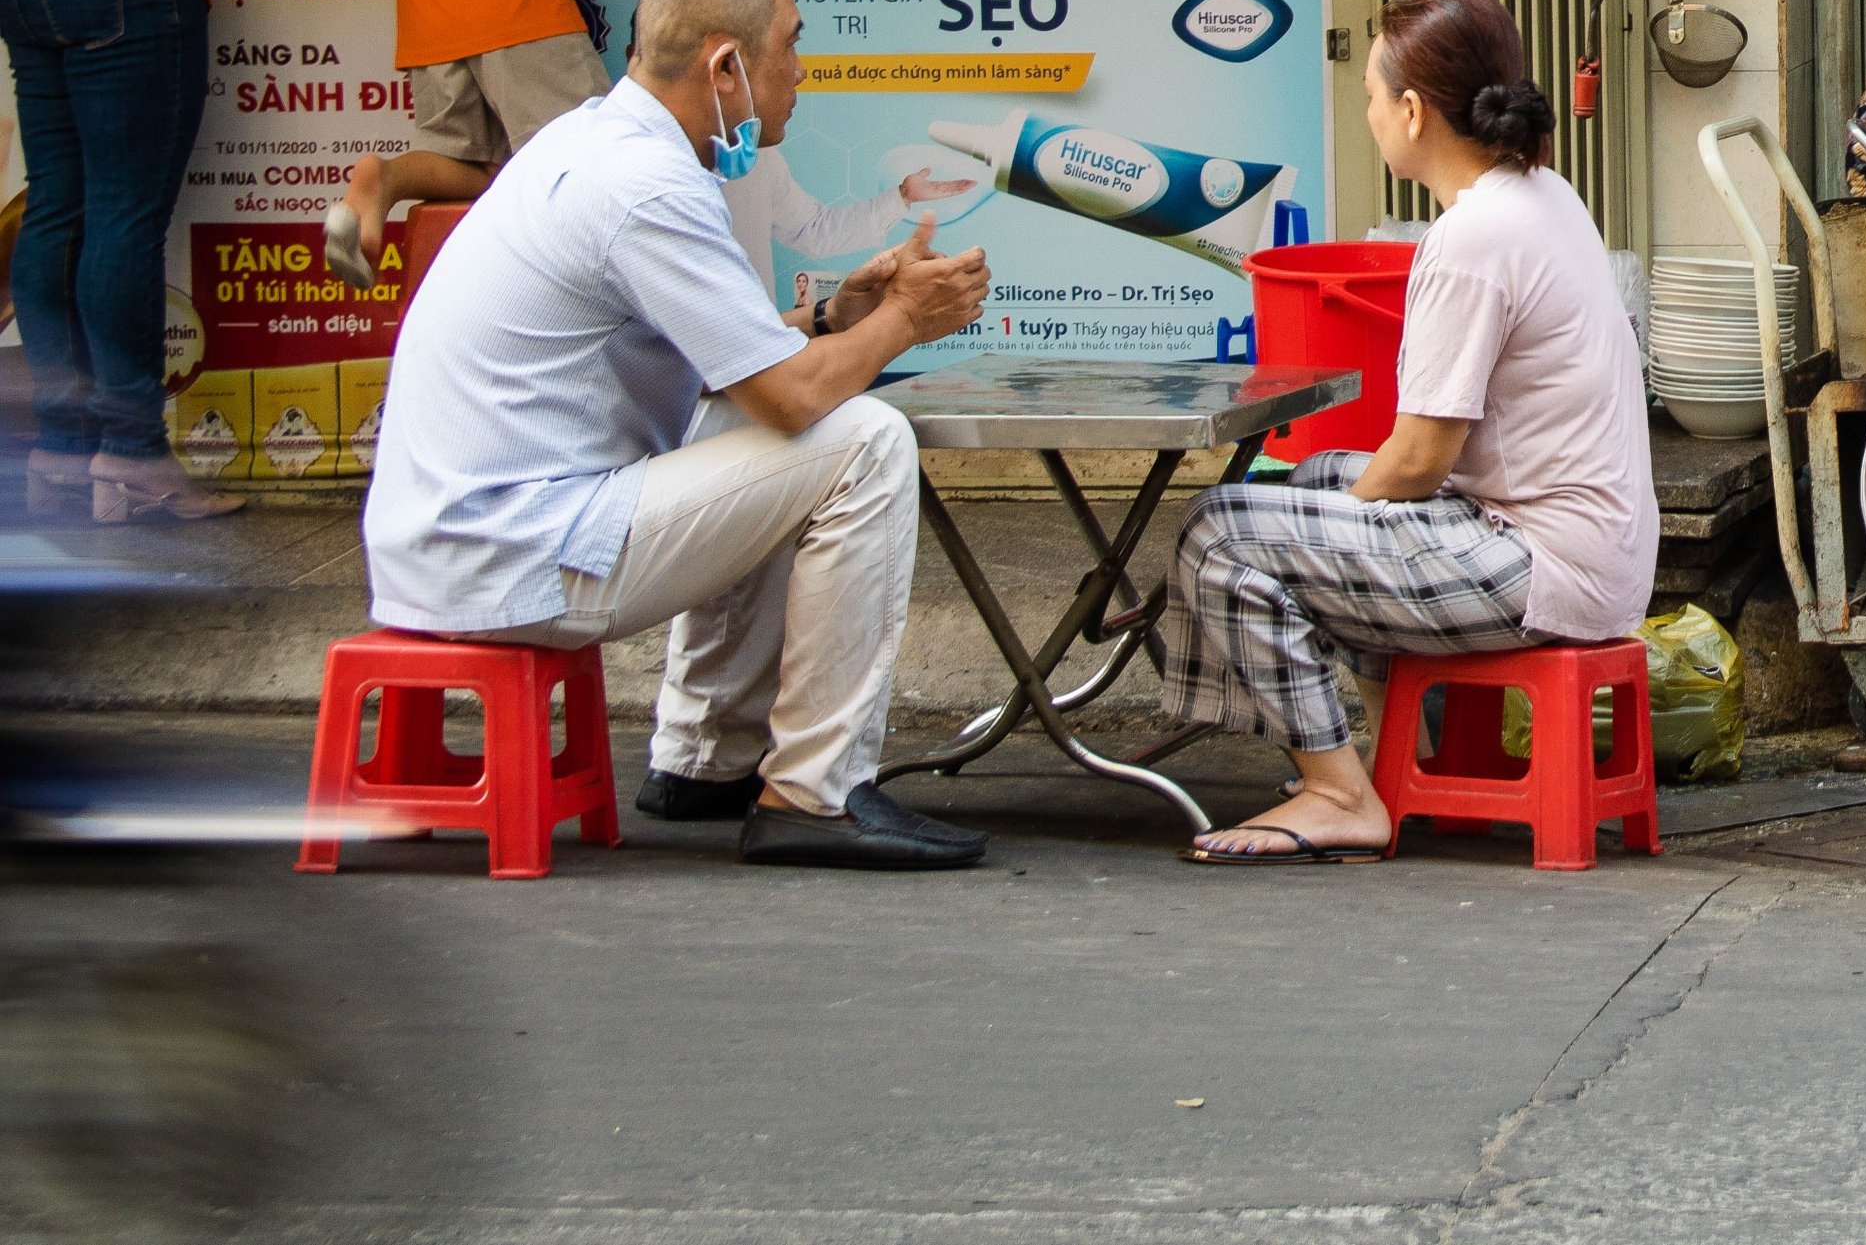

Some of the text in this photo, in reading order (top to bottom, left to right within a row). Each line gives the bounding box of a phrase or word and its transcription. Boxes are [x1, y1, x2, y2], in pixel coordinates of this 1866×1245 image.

[832, 15, 868, 39] TRỊ
[1198, 11, 1259, 25] Hiruscar
[1203, 25, 1253, 34] Silicone Pro
[217, 38, 341, 66] SÁNG DA
[812, 65, 842, 82] quả
[847, 65, 885, 84] được
[891, 64, 941, 83] chứng
[946, 67, 986, 79] minh
[992, 66, 1020, 79] lâm
[237, 73, 344, 113] SÀNH
[216, 141, 234, 154] Từ
[238, 142, 317, 155] 01/11/2020
[332, 140, 411, 154] 31/01/2021
[1060, 138, 1148, 181] Hiruscar
[188, 172, 215, 185] KHI
[221, 172, 257, 185] MUA
[1063, 163, 1133, 193] Silicone Pro
[235, 192, 327, 214] SẮC NGỌC
[215, 238, 312, 279] TẶNG
[216, 281, 245, 302] 01
[256, 279, 287, 302] túi
[294, 279, 345, 302] thời
[994, 285, 1067, 301] Silicone
[1072, 286, 1102, 301] Pro
[1122, 286, 1147, 301] Dr.
[1152, 285, 1174, 305] Trị
[1180, 286, 1214, 306] Sẹo
[268, 314, 372, 337] sành điệu
[1001, 316, 1011, 336] 1
[1019, 318, 1068, 340] tuýp
[1073, 320, 1107, 339] Thấy
[1112, 325, 1147, 339] ngay
[1151, 321, 1182, 338] hiệu
[1187, 321, 1214, 338] quả
